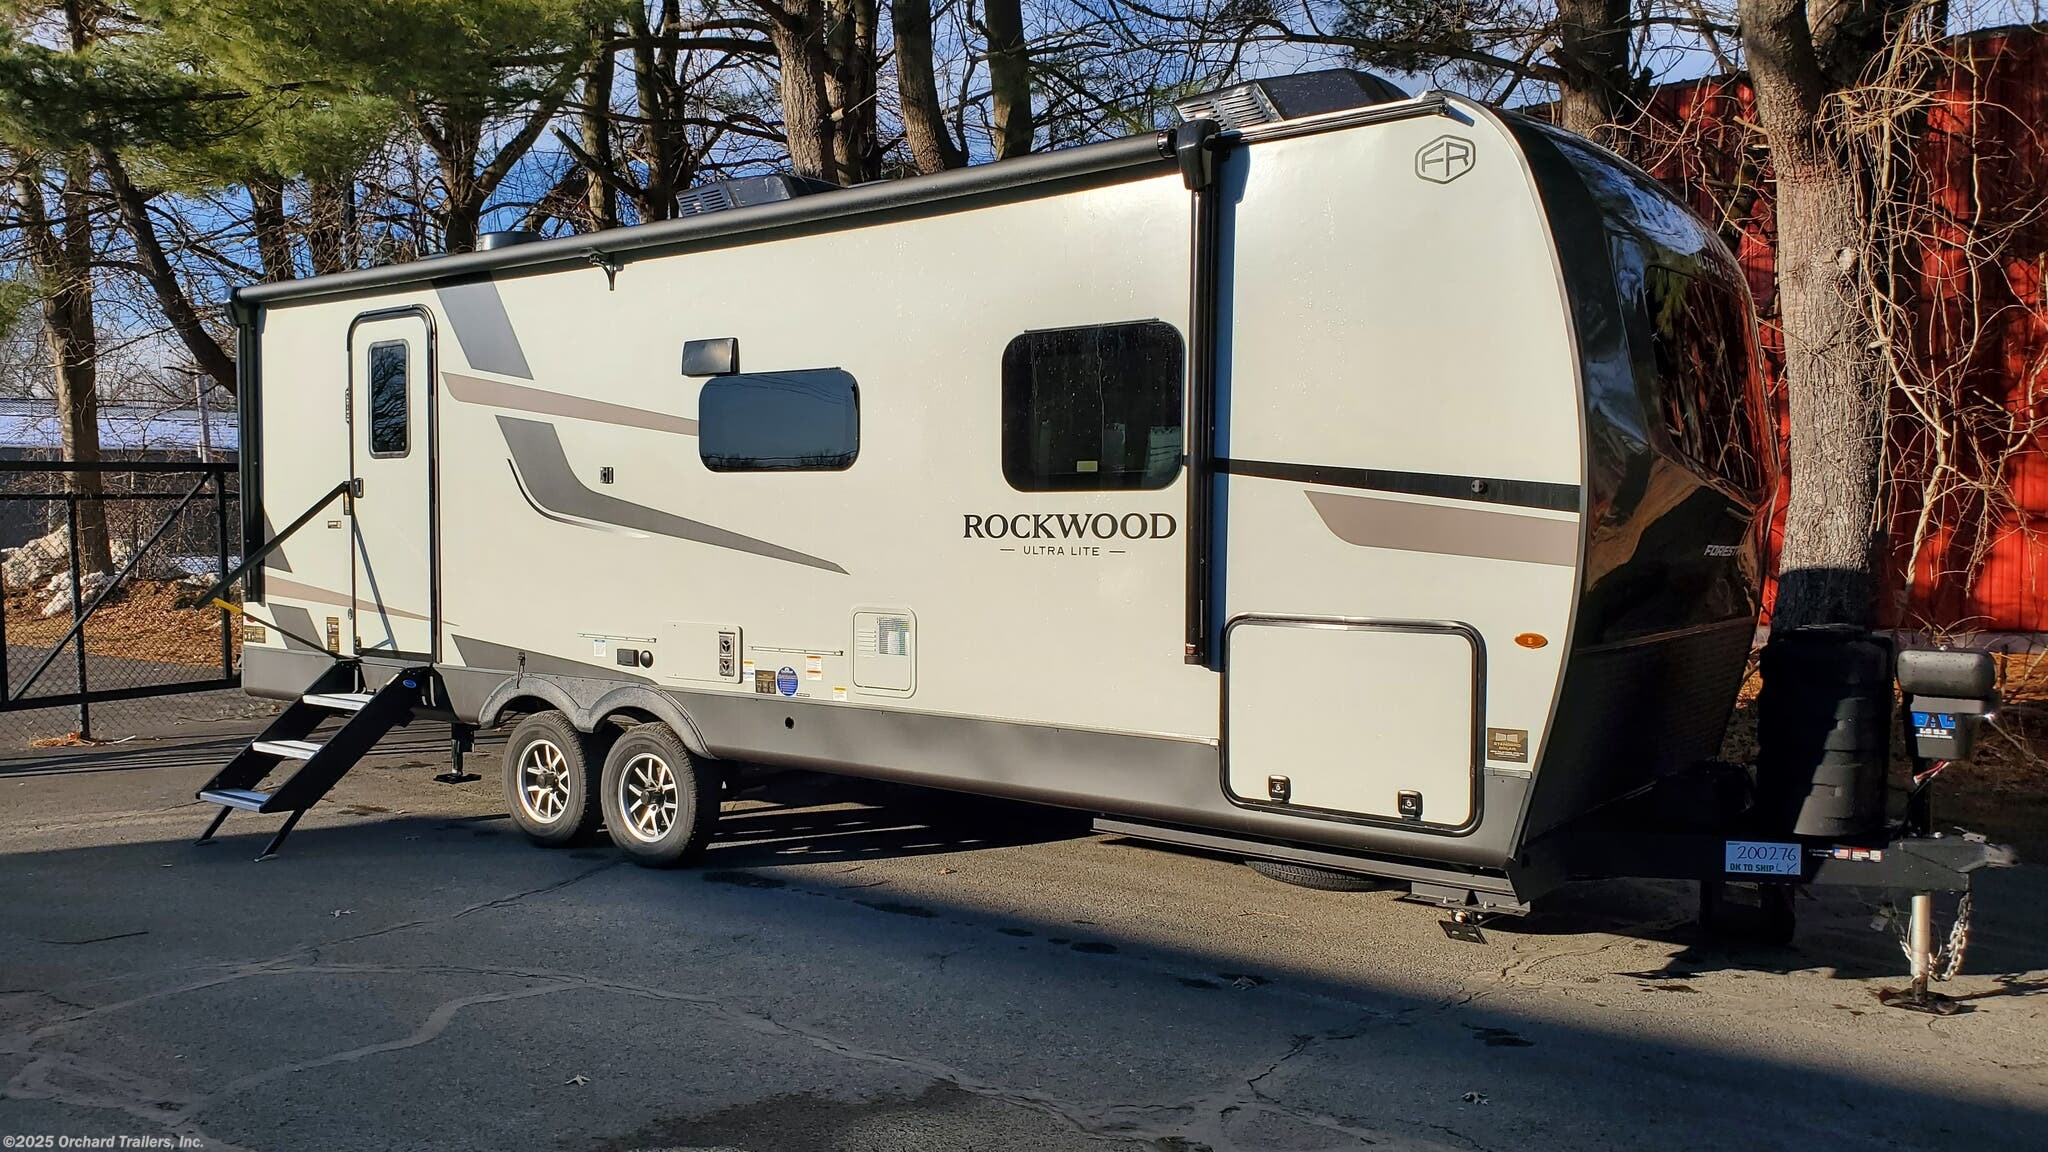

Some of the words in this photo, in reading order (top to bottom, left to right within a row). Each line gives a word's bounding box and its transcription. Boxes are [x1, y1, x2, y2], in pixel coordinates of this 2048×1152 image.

[963, 513, 1177, 540] ROCKWOOD
[1023, 546, 1065, 556] ULTRA
[1070, 546, 1100, 557] LITE
[1737, 845, 1797, 861] 200276
[1730, 863, 1741, 871] OK
[1744, 863, 1752, 871] TO
[1755, 864, 1774, 872] SHIP
